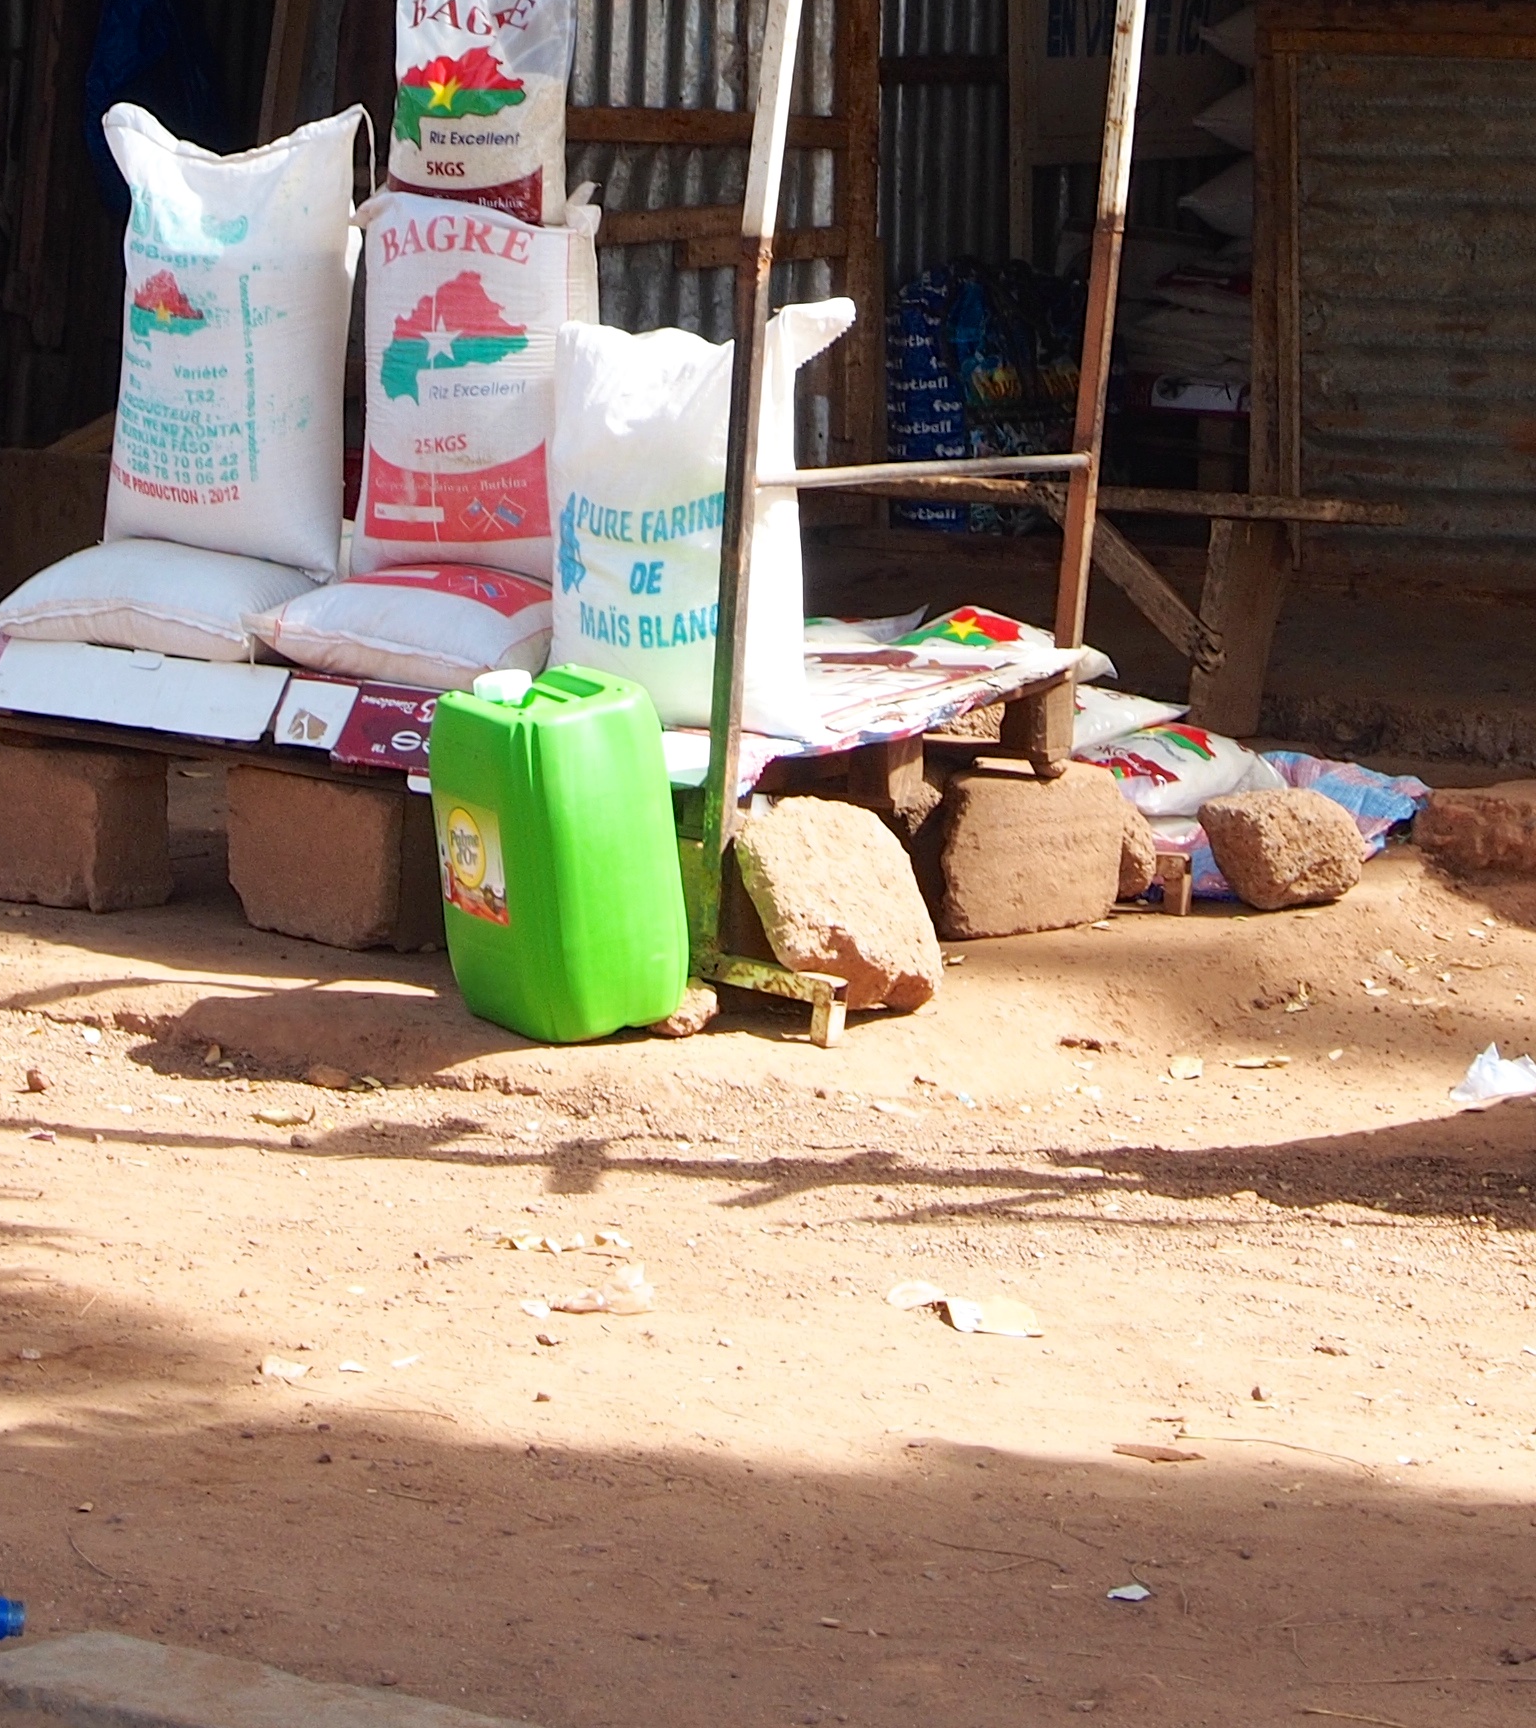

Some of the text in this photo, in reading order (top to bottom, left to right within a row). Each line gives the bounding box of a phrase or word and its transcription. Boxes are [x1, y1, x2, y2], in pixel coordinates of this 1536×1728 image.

[429, 131, 520, 146] Riz Excellent
[426, 161, 465, 177] 5KGS
[429, 380, 527, 401] Riz Excellent
[414, 434, 468, 455] 25KGS
[133, 479, 199, 505] PRODUCTION
[208, 484, 240, 505] 2012
[577, 499, 634, 543] PURE
[630, 560, 664, 595] DE
[580, 601, 630, 646] MAÏS
